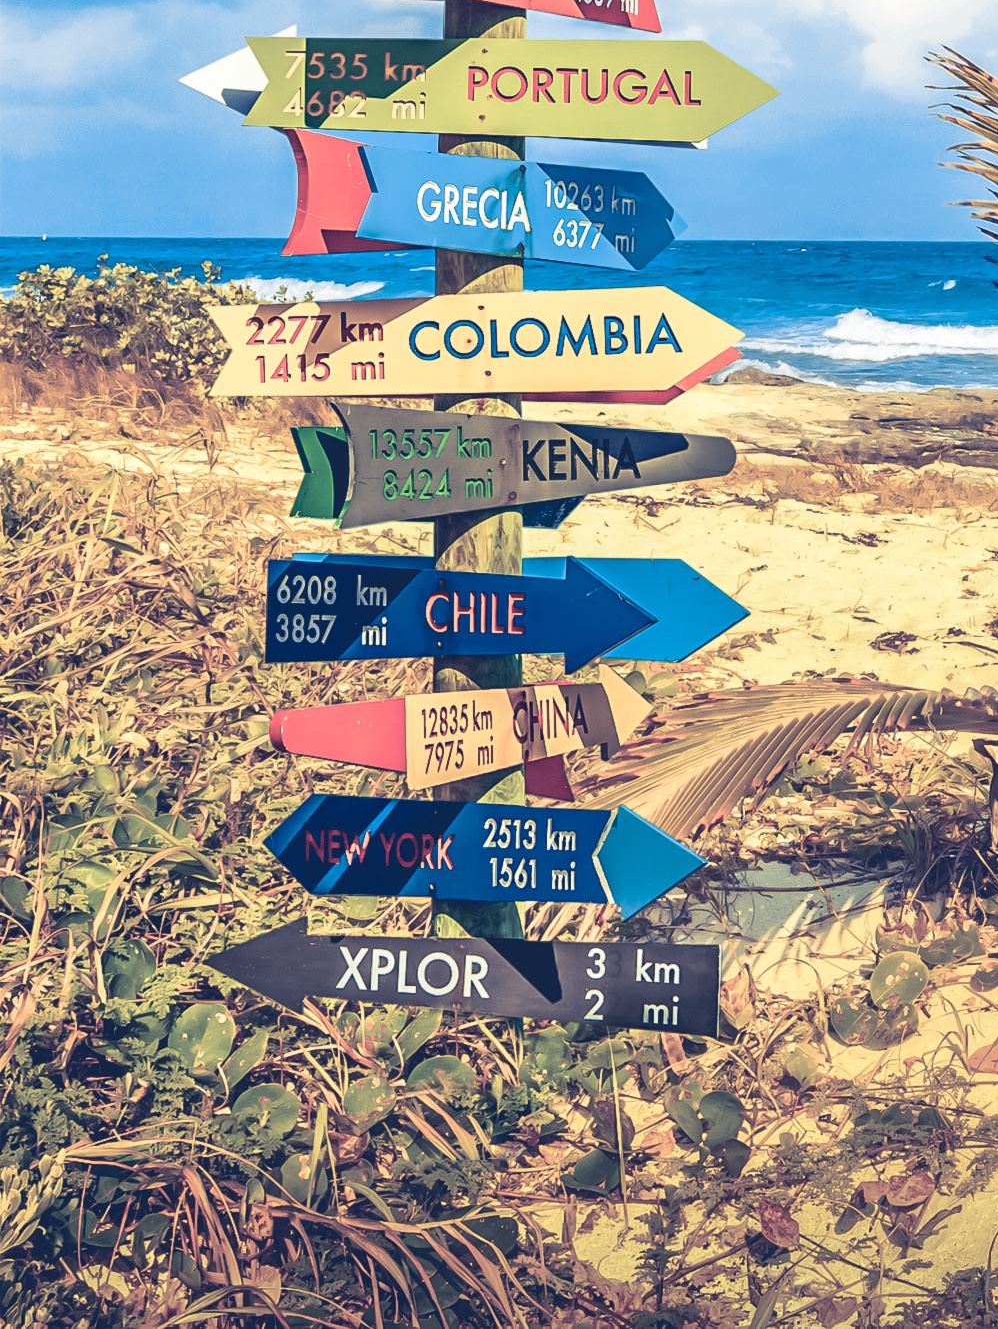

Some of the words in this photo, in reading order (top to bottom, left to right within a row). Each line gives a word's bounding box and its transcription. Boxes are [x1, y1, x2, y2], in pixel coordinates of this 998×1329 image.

[285, 51, 368, 80] 7535
[384, 52, 427, 82] km
[283, 87, 366, 117] 4682
[391, 92, 427, 119] mi
[466, 65, 702, 108] PORTUGAL
[416, 180, 532, 234] GRECIA
[544, 179, 604, 214] 10263
[610, 183, 637, 217] km
[552, 220, 603, 252] 6377
[614, 226, 636, 255] mi
[245, 314, 330, 347] 2277
[340, 311, 384, 344] km
[408, 312, 683, 361] COLOMBIA
[255, 351, 331, 384] 1415
[351, 352, 386, 382] mi
[369, 428, 450, 461] 13557
[455, 426, 493, 459] km
[522, 436, 643, 483] KENIA
[382, 468, 452, 502] 8424
[464, 468, 493, 499] mi
[275, 575, 338, 607] 6208
[356, 574, 388, 607] km
[275, 614, 337, 646] 3857
[361, 616, 388, 647] mi
[424, 590, 527, 636] CHILE
[420, 703, 469, 739] 12835
[473, 700, 493, 732] km
[513, 693, 589, 744] CHINA
[424, 740, 465, 774] 7975
[477, 735, 494, 767] mi
[305, 828, 371, 866] NEW
[380, 832, 455, 871] YORK
[483, 817, 537, 852] 2513
[546, 819, 577, 853] km
[489, 857, 537, 890] 1561
[551, 861, 576, 892] mi
[335, 946, 490, 1000] XPLOR
[586, 948, 606, 979] 3
[635, 949, 680, 984] km
[583, 989, 604, 1020] 2
[643, 996, 679, 1025] mi
